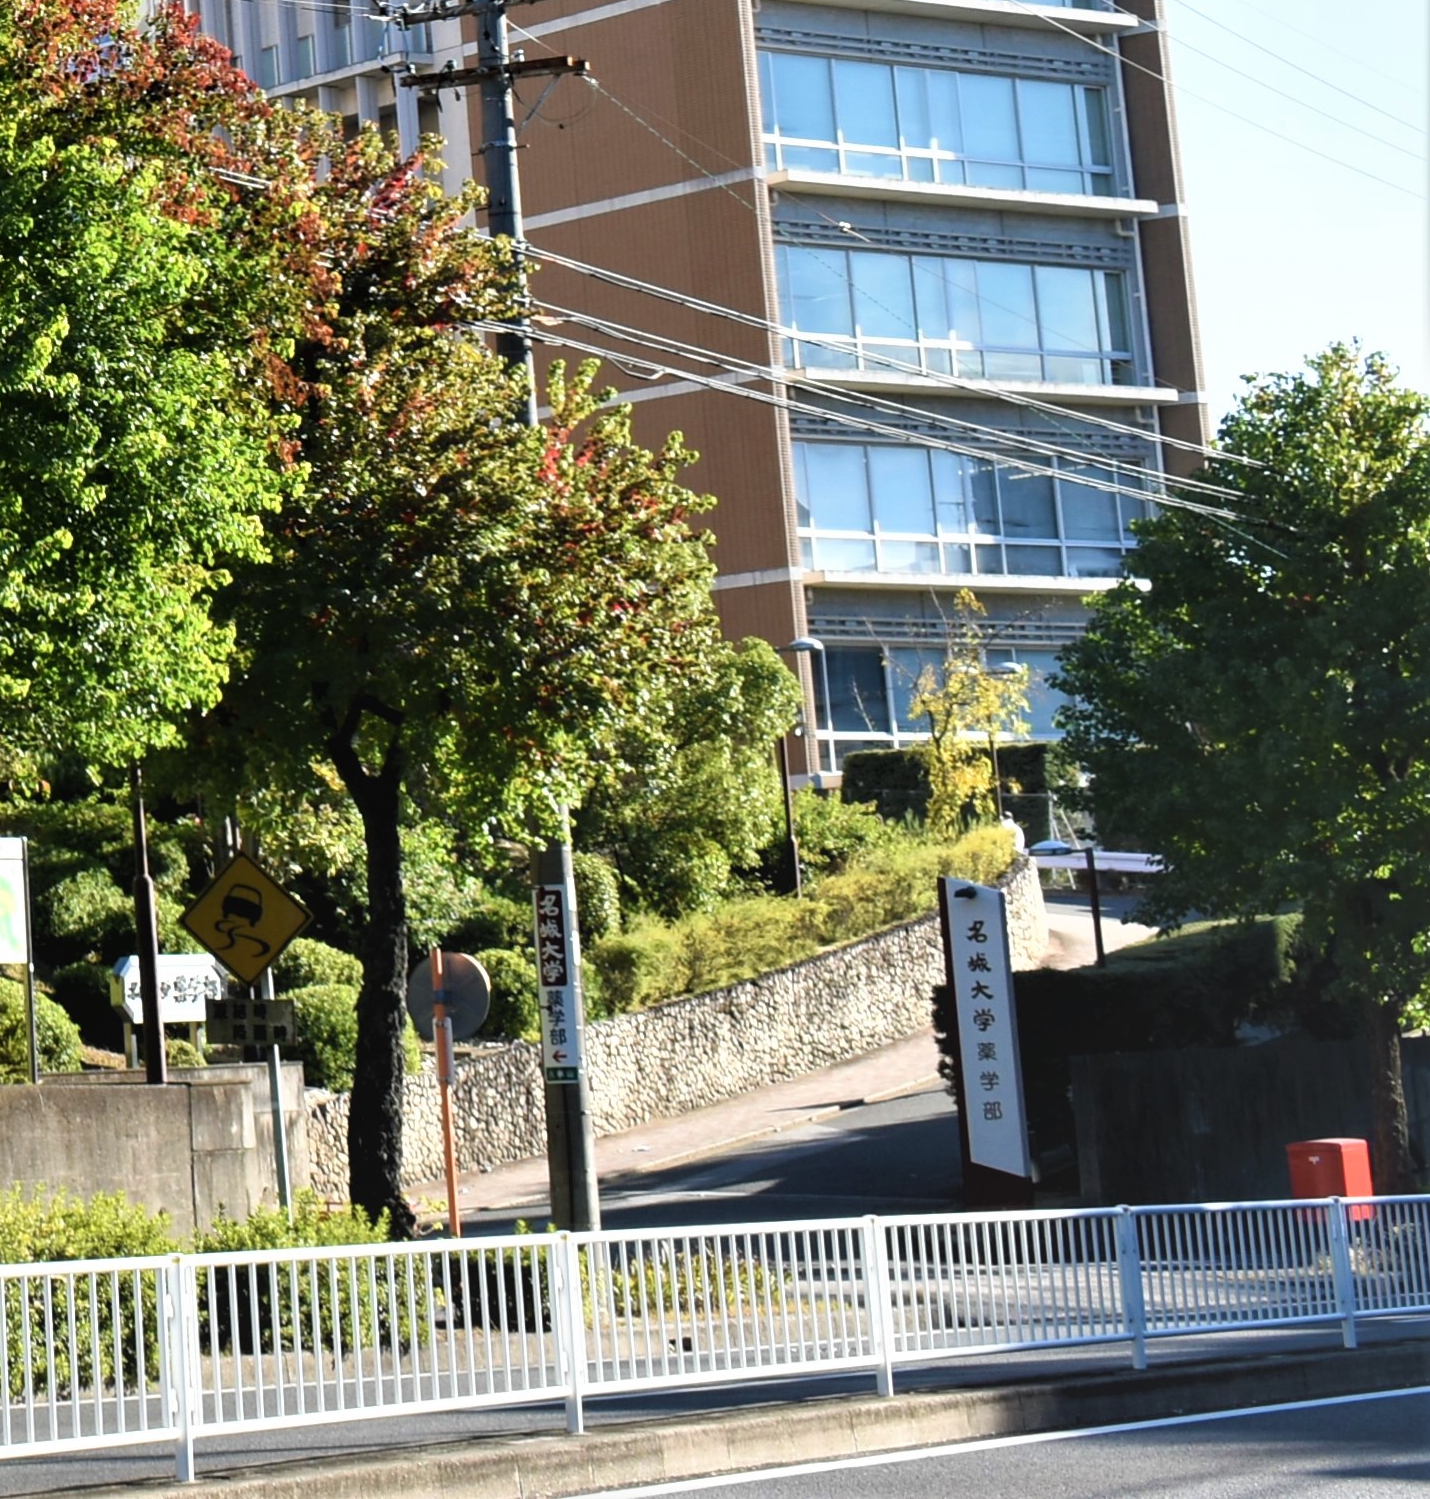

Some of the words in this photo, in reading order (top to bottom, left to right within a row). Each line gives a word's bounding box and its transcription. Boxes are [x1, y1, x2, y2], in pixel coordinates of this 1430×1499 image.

[539, 894, 564, 983] 名城大学
[547, 989, 567, 1045] 薬学部
[966, 920, 1003, 1121] 名城大学薬学部
